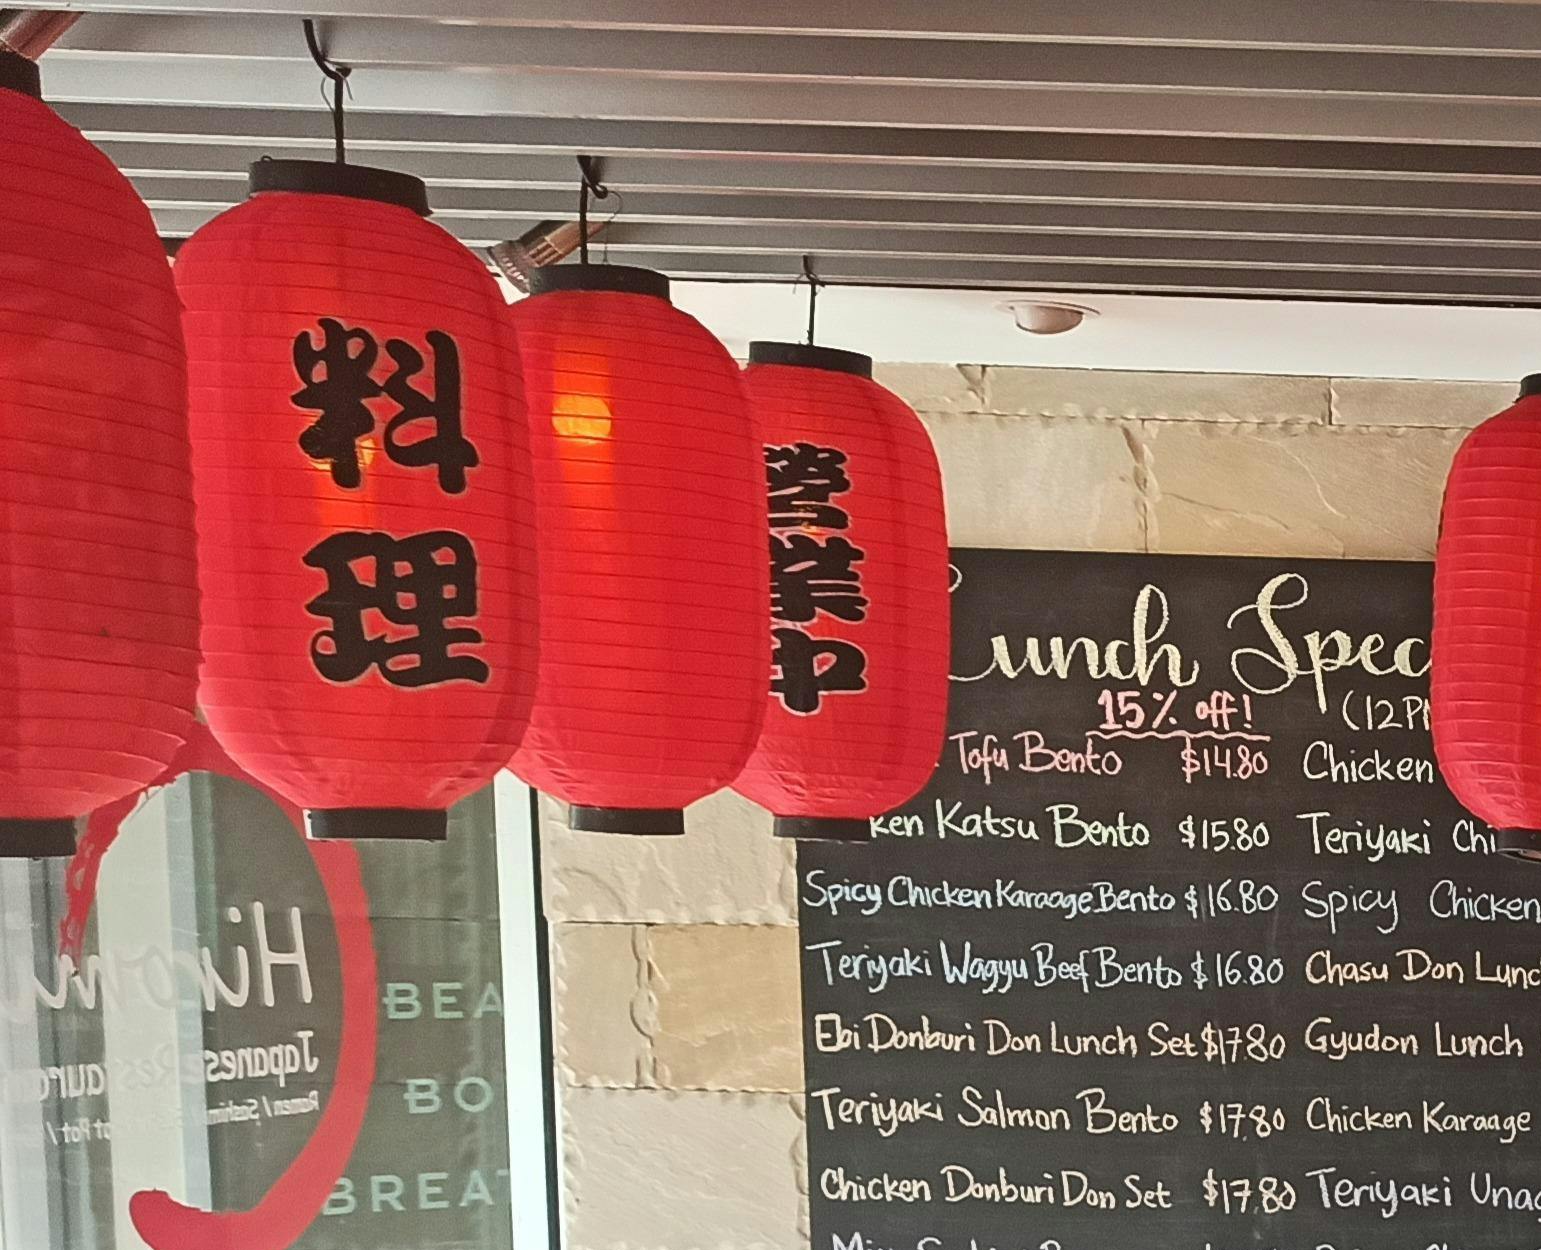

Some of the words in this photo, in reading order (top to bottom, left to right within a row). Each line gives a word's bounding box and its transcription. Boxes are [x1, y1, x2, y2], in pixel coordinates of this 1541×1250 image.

[290, 317, 491, 687] 料理
[948, 564, 1198, 687] unch
[1098, 689, 1177, 730] 15%
[1196, 690, 1252, 730] off!
[949, 731, 1009, 785] Tofu
[1012, 731, 1123, 776] Bento
[1179, 735, 1270, 783] $14.80
[1303, 741, 1433, 783] Chicken
[936, 799, 1039, 840] Katsu
[1046, 804, 1149, 848] Bento
[1179, 815, 1269, 852] $15.80
[1296, 812, 1430, 862] Teriyaki
[803, 870, 882, 915] Spicy
[888, 876, 992, 909] Chicken
[1092, 882, 1175, 913] Bento
[1302, 881, 1398, 934] Spicy
[1430, 880, 1541, 923] Chicken
[805, 940, 932, 993] Teriyaki
[940, 940, 1028, 994] Wagyu
[1031, 943, 1089, 993] Beef
[1092, 947, 1182, 989] Bento
[1306, 950, 1388, 986] Chasu
[1396, 949, 1464, 983] Don
[815, 1013, 860, 1052] Ebi
[863, 1013, 975, 1053] Donburi
[983, 1020, 1041, 1055] Don
[1051, 1021, 1137, 1057] Lunch
[1148, 1022, 1198, 1057] Set
[1201, 1022, 1285, 1064] $17.80
[1305, 1017, 1418, 1060] Gyudon
[1435, 1022, 1523, 1057] Lunch
[403, 1077, 494, 1114] BO
[811, 1087, 943, 1137] Teriyaki
[958, 1086, 1070, 1130] Salmon
[1076, 1088, 1178, 1134] Bento
[1200, 1101, 1285, 1141] $17.80
[1307, 1097, 1412, 1133] Chicken
[1423, 1101, 1530, 1143] Karaage
[821, 1167, 931, 1202] Chicken
[940, 1165, 1054, 1204] Donburi
[1061, 1171, 1115, 1209] Don
[1124, 1175, 1172, 1208] Set
[1203, 1168, 1296, 1214] $17.80
[1305, 1167, 1451, 1218] Teriyaki
